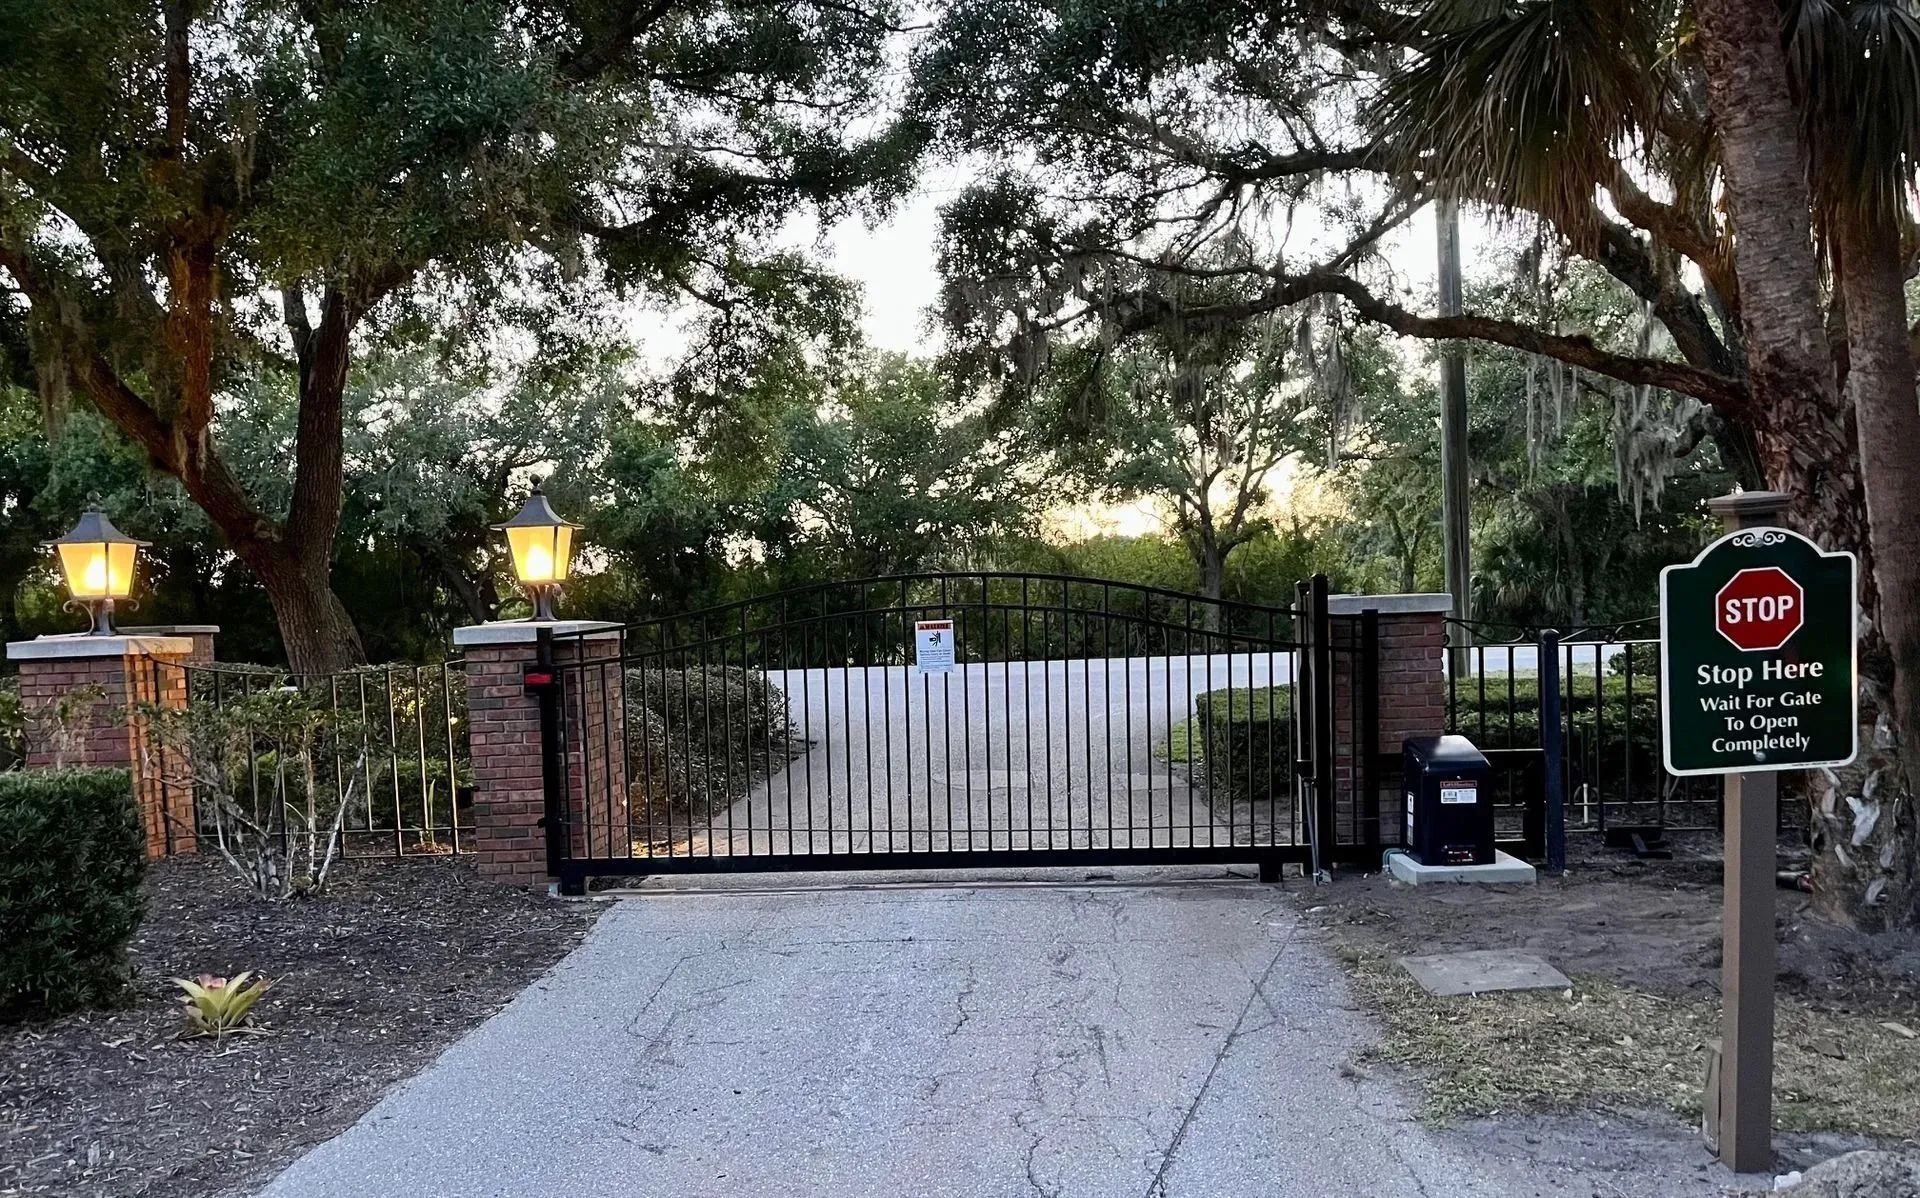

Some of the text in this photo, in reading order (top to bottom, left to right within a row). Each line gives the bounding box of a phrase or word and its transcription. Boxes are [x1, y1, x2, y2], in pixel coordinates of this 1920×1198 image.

[1725, 595, 1794, 624] STOP
[1697, 660, 1824, 689] Stop Here
[1700, 691, 1822, 712] Wait For Gate
[1724, 714, 1798, 733] To Open
[1712, 732, 1811, 755] Completely
